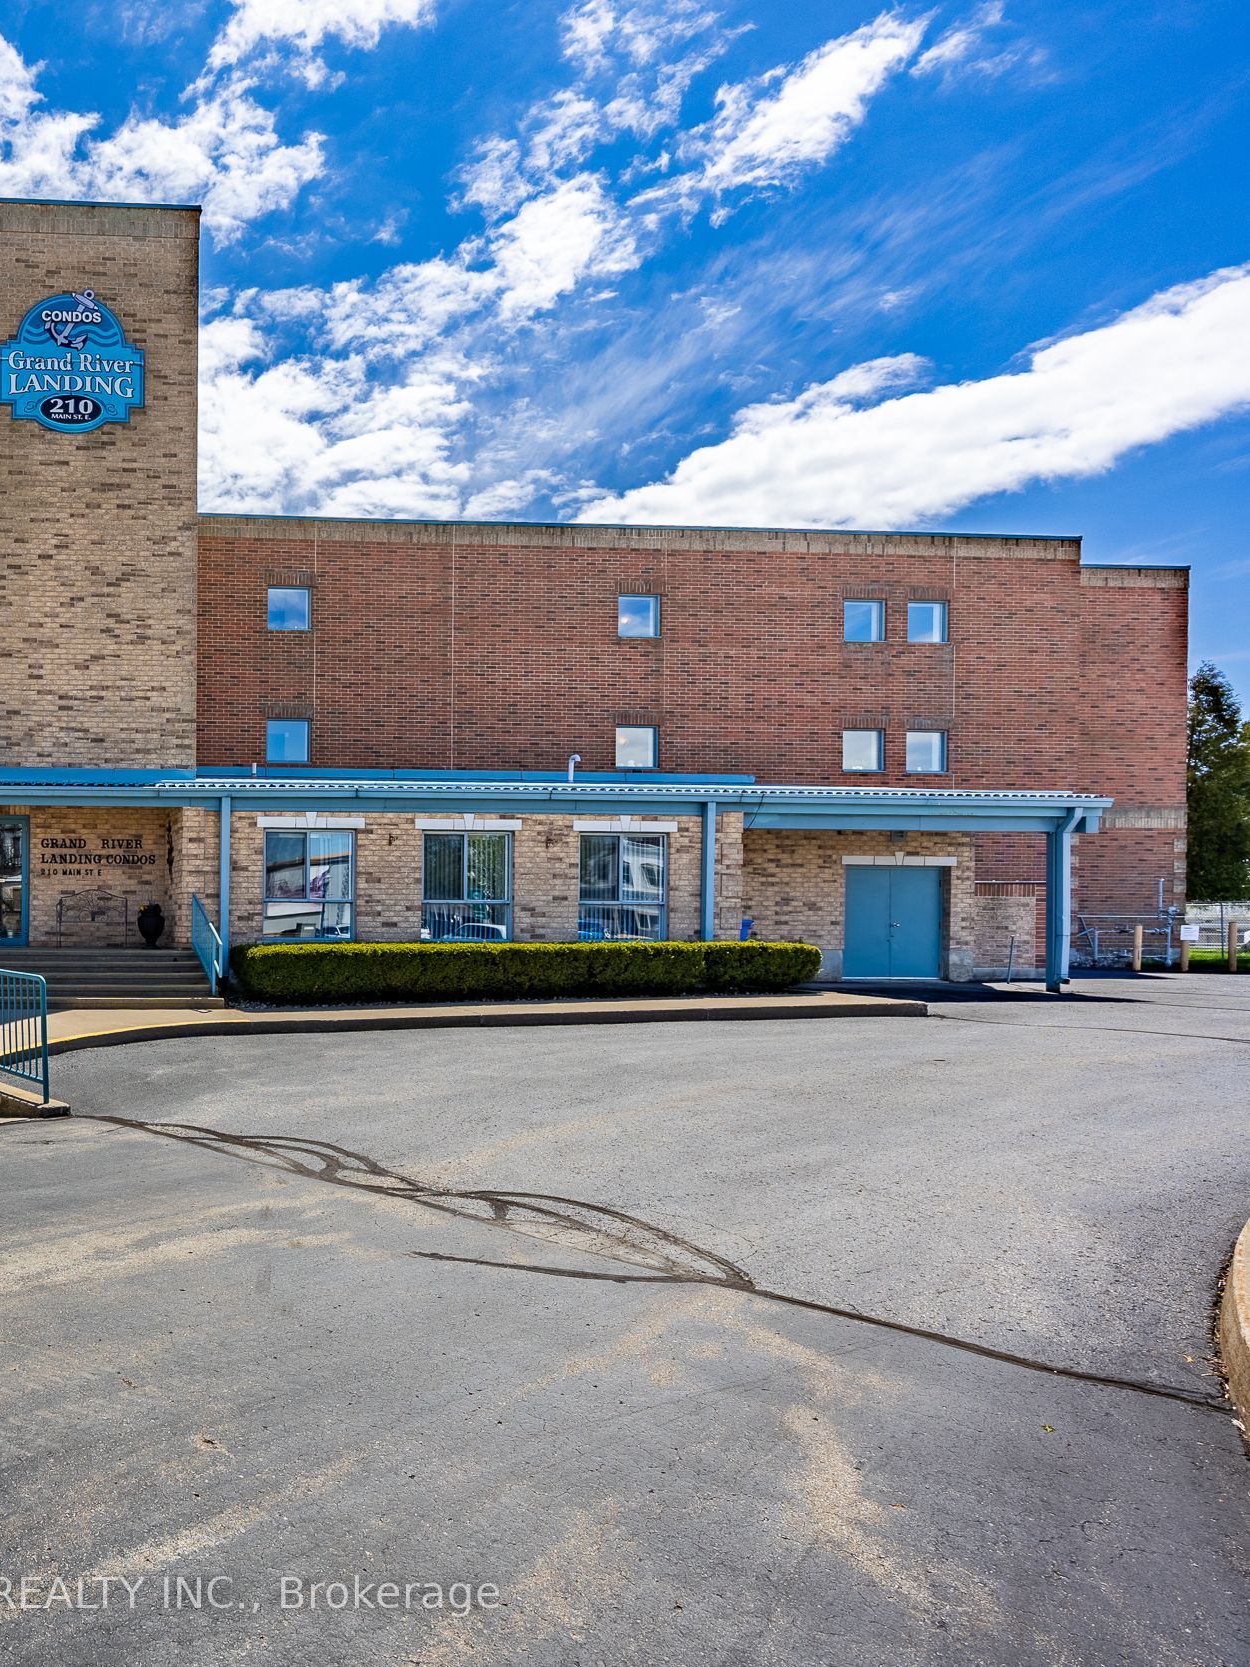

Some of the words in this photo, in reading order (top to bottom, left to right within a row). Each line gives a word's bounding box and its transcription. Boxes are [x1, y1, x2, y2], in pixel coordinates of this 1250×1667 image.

[41, 310, 102, 323] CONDOS
[8, 350, 72, 372] Grand
[78, 353, 134, 373] River
[8, 373, 134, 398] LANDING
[49, 398, 94, 414] 210
[40, 838, 87, 849] GRAND
[100, 838, 143, 849] RIVER
[40, 854, 103, 864] LANDING
[106, 854, 156, 865] CONDOS
[40, 868, 58, 876] 210
[62, 868, 82, 876] MAIN
